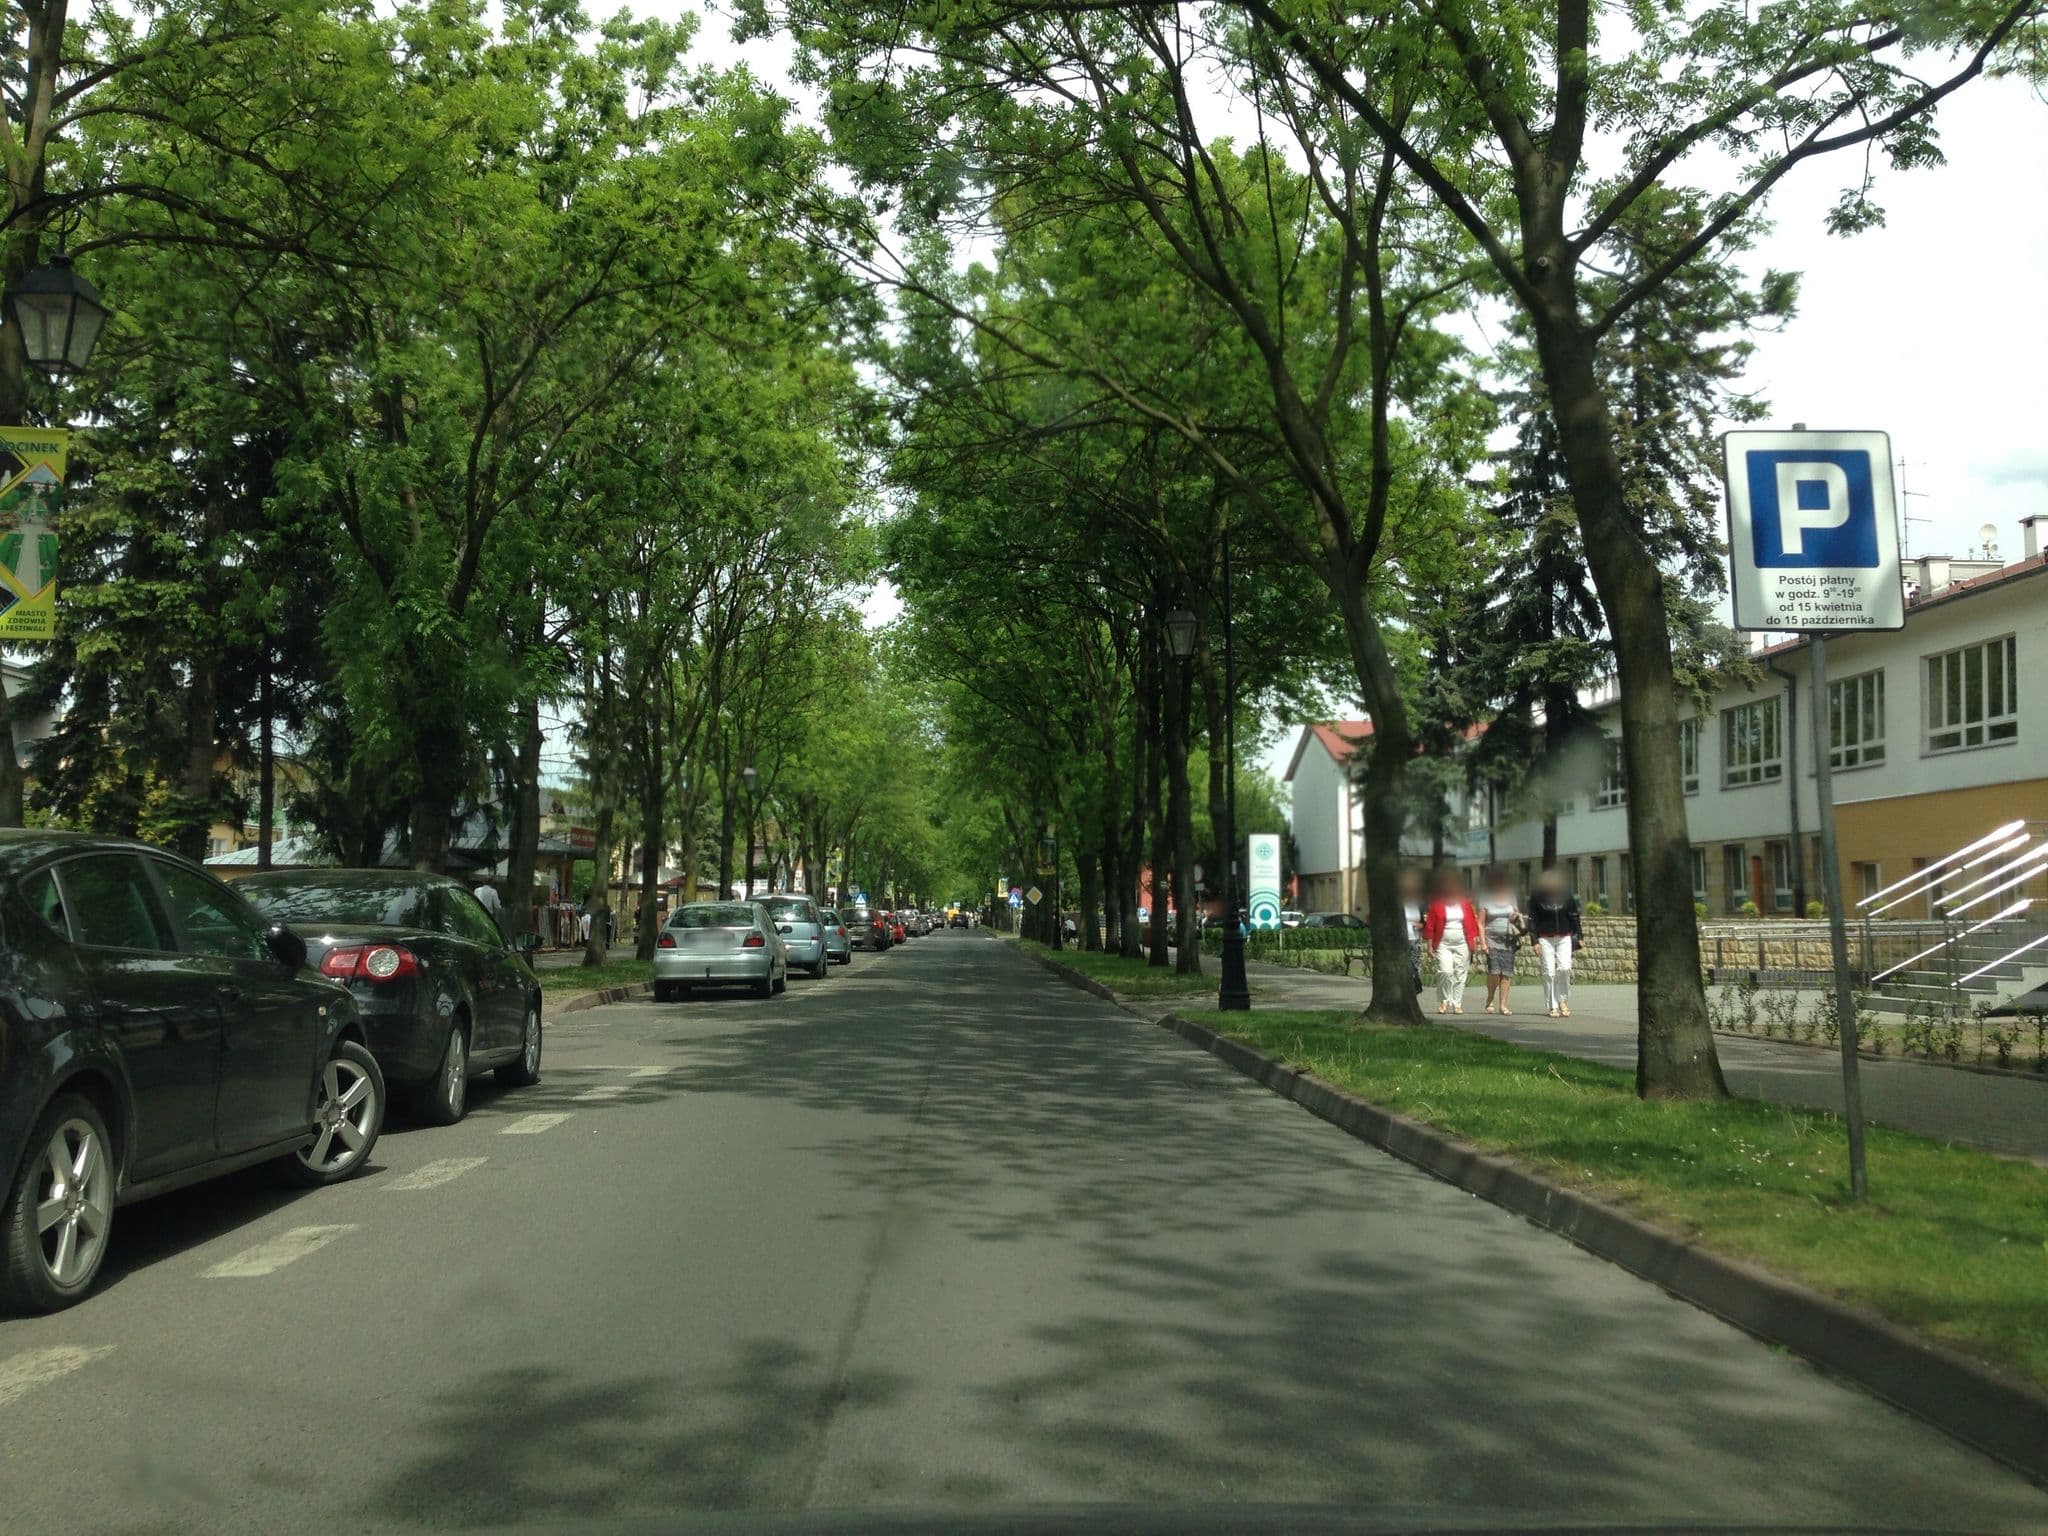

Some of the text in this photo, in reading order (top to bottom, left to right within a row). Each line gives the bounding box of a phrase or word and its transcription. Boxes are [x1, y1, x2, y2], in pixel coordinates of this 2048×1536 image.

[1775, 462, 1850, 554] P
[1779, 575, 1855, 587] Postój płatny
[1788, 589, 1820, 600] godz.
[1779, 602, 1862, 611] od 15 kwietnia
[1766, 615, 1875, 626] do 15 października
